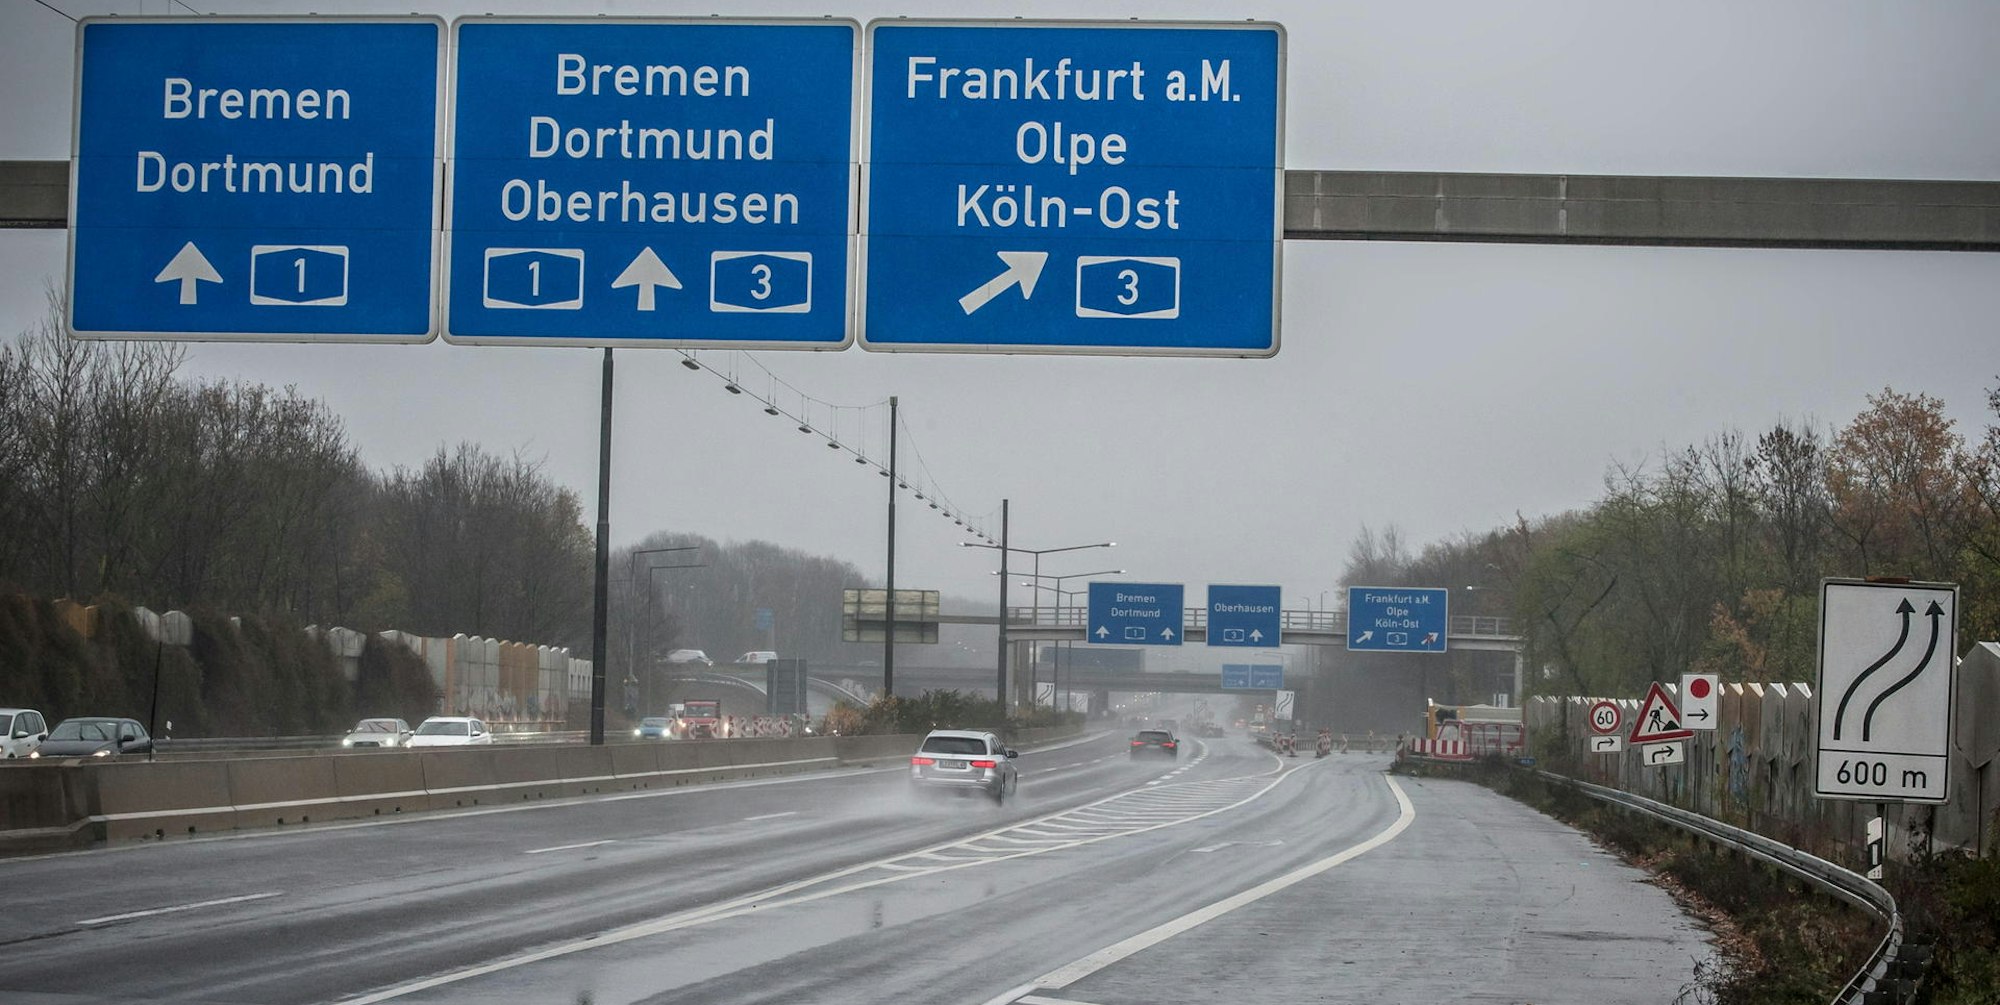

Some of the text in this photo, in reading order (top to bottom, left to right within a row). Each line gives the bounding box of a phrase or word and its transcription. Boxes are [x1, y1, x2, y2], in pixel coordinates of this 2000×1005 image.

[557, 53, 750, 97] Bremen
[907, 56, 1241, 102] Frankfurt a.M.
[165, 79, 350, 119] Bremen
[529, 116, 774, 161] Dortmund
[1016, 121, 1127, 175] Olpe
[137, 152, 373, 194] Dortmund
[501, 179, 799, 224] Oberhausen
[957, 184, 1180, 230] Köln-Ost
[294, 258, 304, 293] 1
[528, 261, 540, 296] 1
[750, 264, 772, 300] 3
[1117, 269, 1139, 306] 3
[1111, 607, 1160, 618] Dortmund
[1116, 593, 1156, 603] Bremen
[1214, 603, 1274, 613] Oberhausen
[1365, 594, 1412, 604] Frankfurt
[1386, 606, 1408, 617] Olpe
[1231, 631, 1237, 640] 3
[1375, 618, 1419, 629] Köln-Ost
[1597, 711, 1614, 725] 60
[1837, 760, 1927, 789] 600 m
